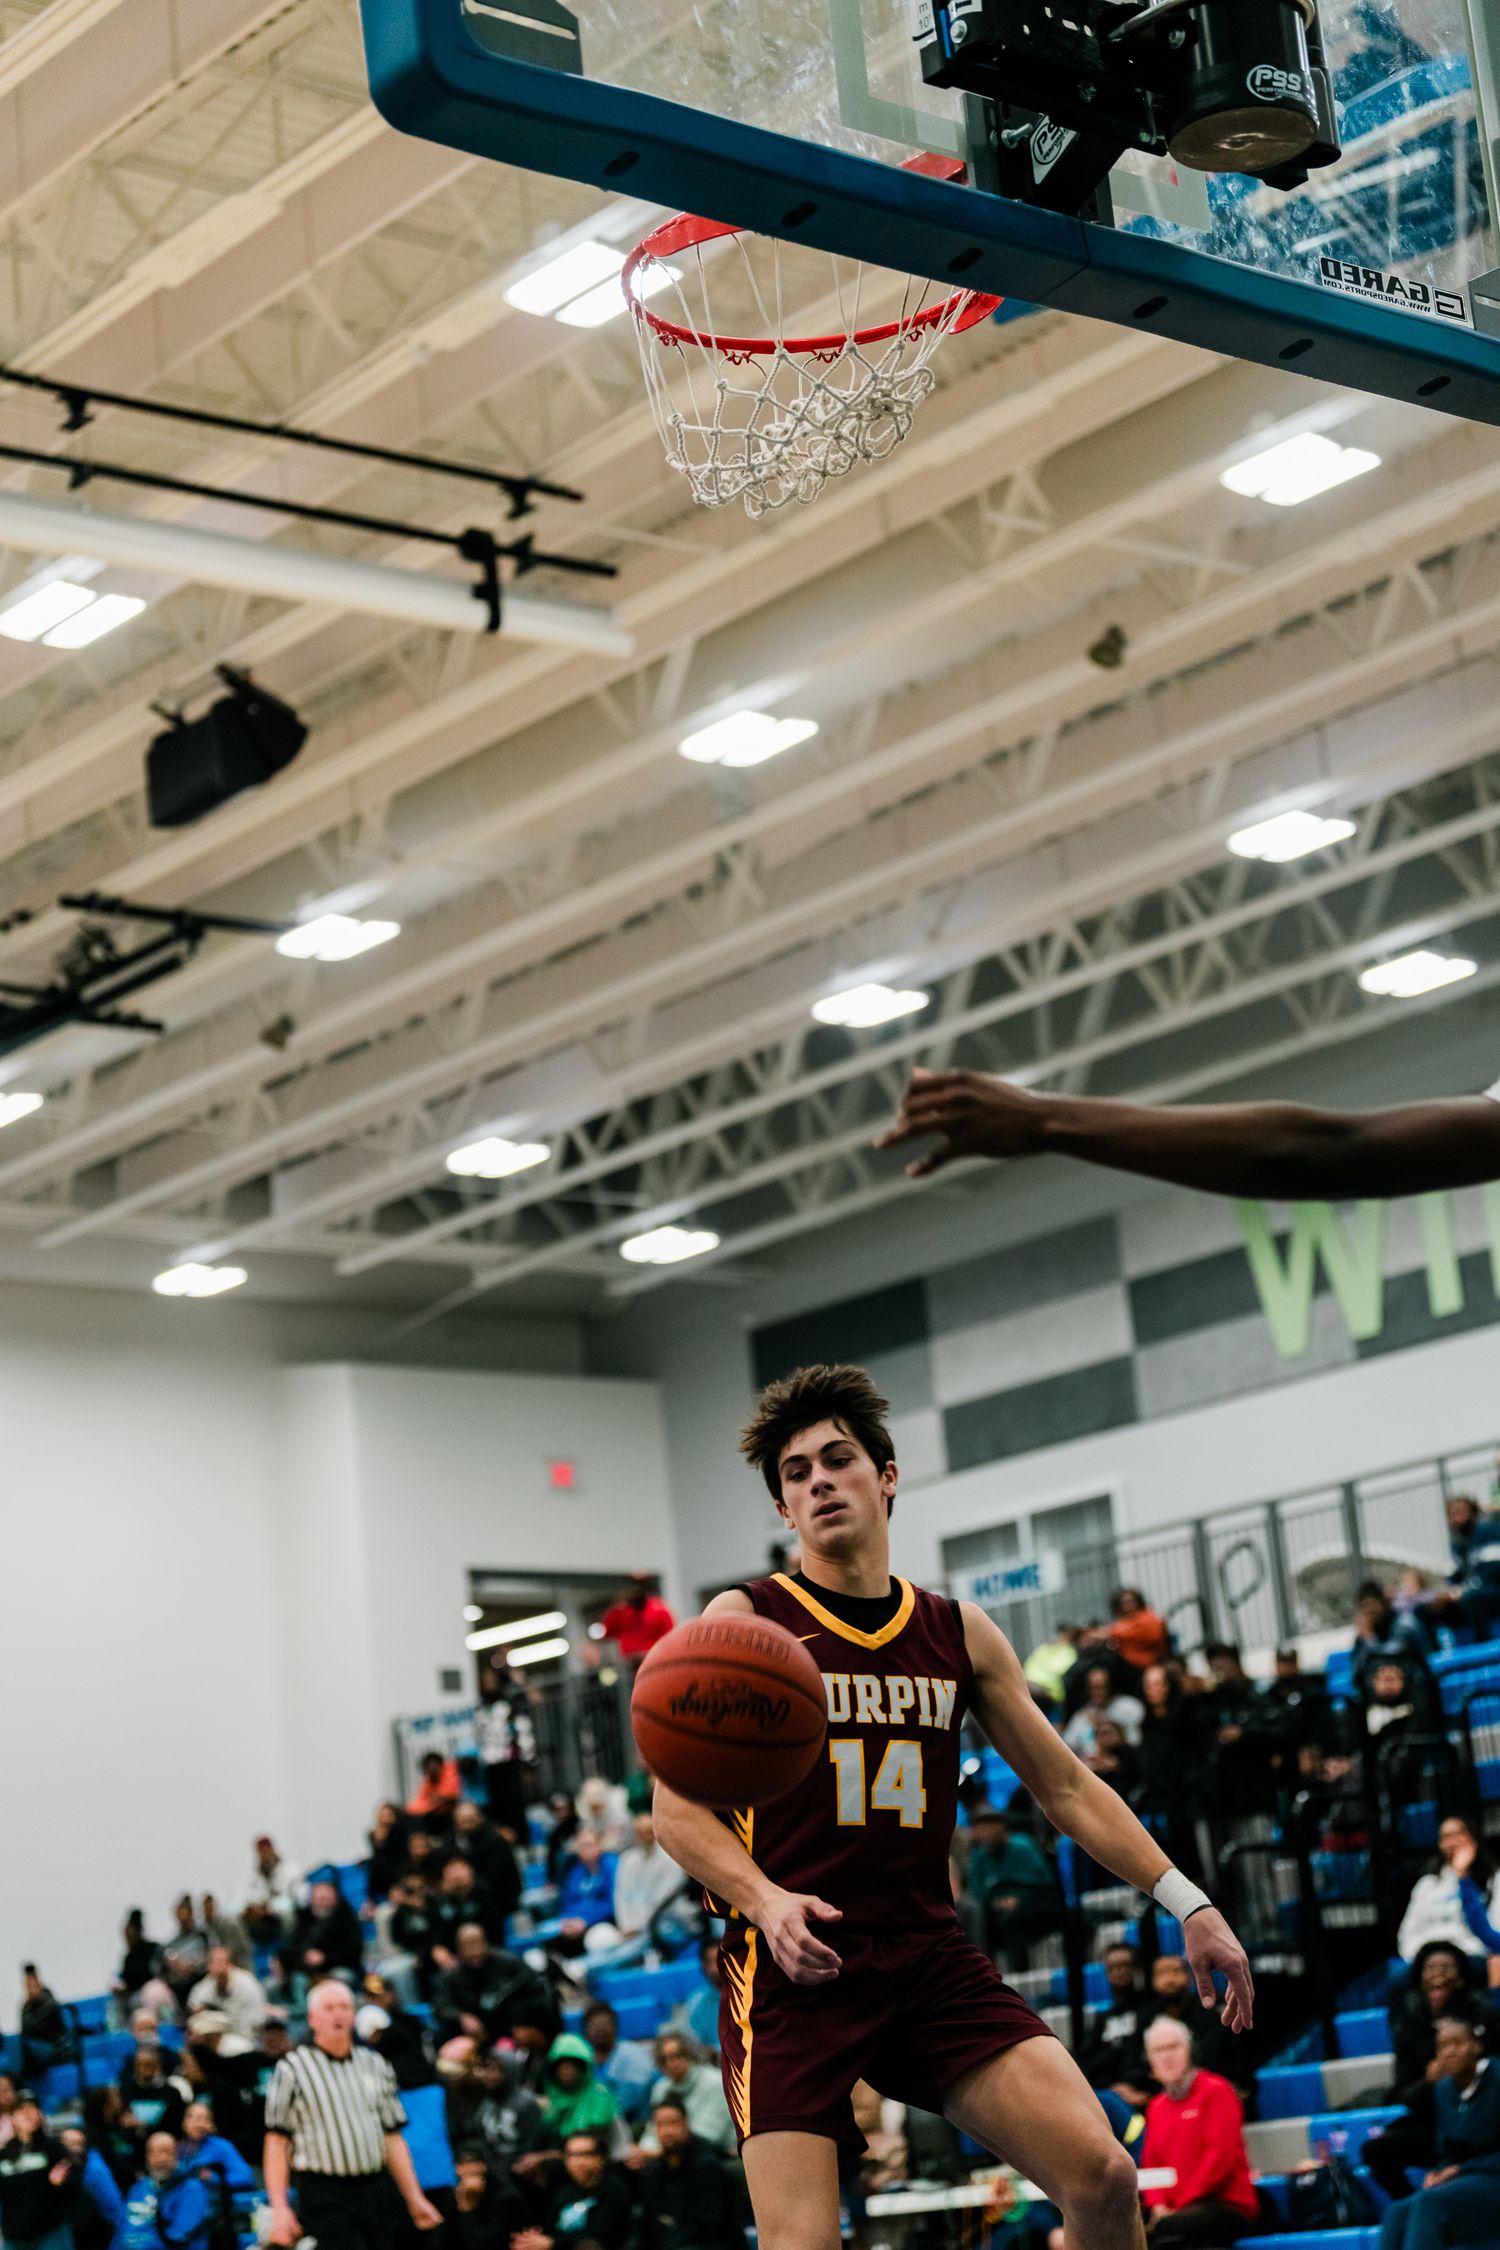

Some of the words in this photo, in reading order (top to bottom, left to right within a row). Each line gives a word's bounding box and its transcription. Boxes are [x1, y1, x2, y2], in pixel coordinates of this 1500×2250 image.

[1255, 69, 1302, 91] PSS
[1234, 1180, 1500, 1356] WI
[829, 1738, 927, 1829] 14
